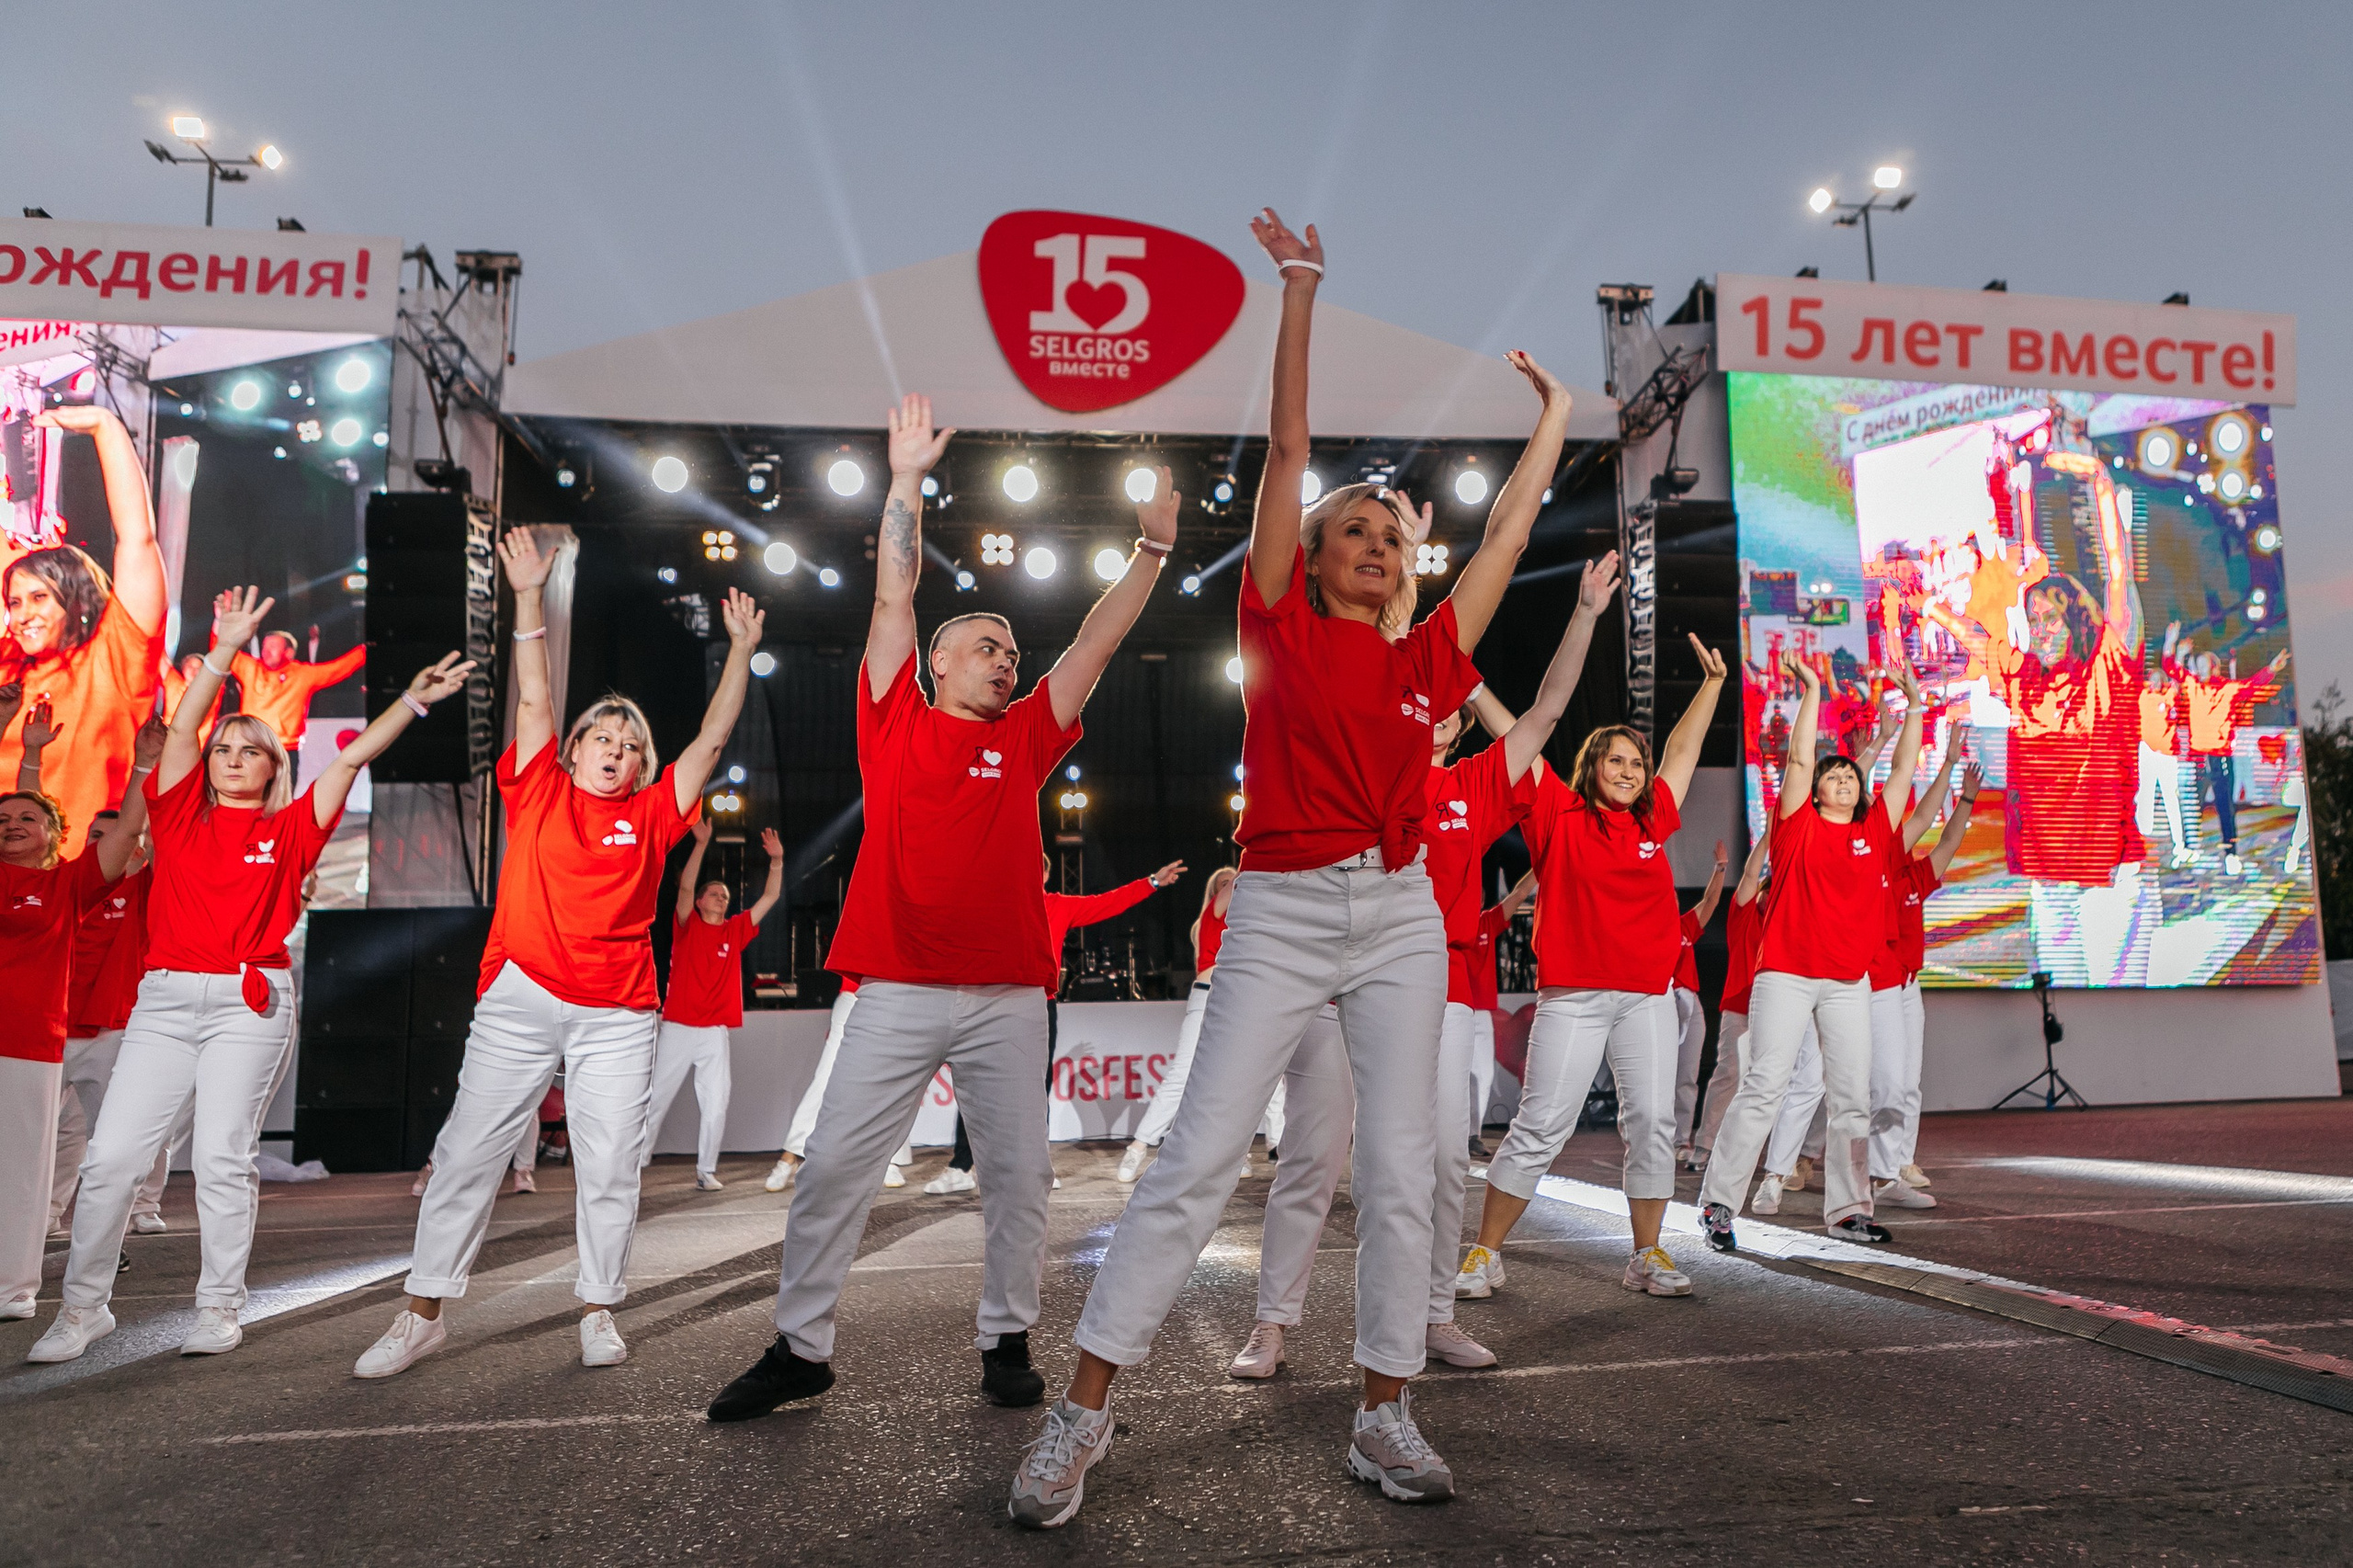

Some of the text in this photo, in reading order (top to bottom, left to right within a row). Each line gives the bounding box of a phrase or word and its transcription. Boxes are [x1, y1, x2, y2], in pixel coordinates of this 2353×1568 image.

[1029, 232, 1152, 335] 15
[1029, 335, 1152, 362] SELGROS
[1740, 294, 2276, 392] 15 лет вместе!
[1049, 360, 1131, 379] вместе
[1435, 801, 1450, 820] Я
